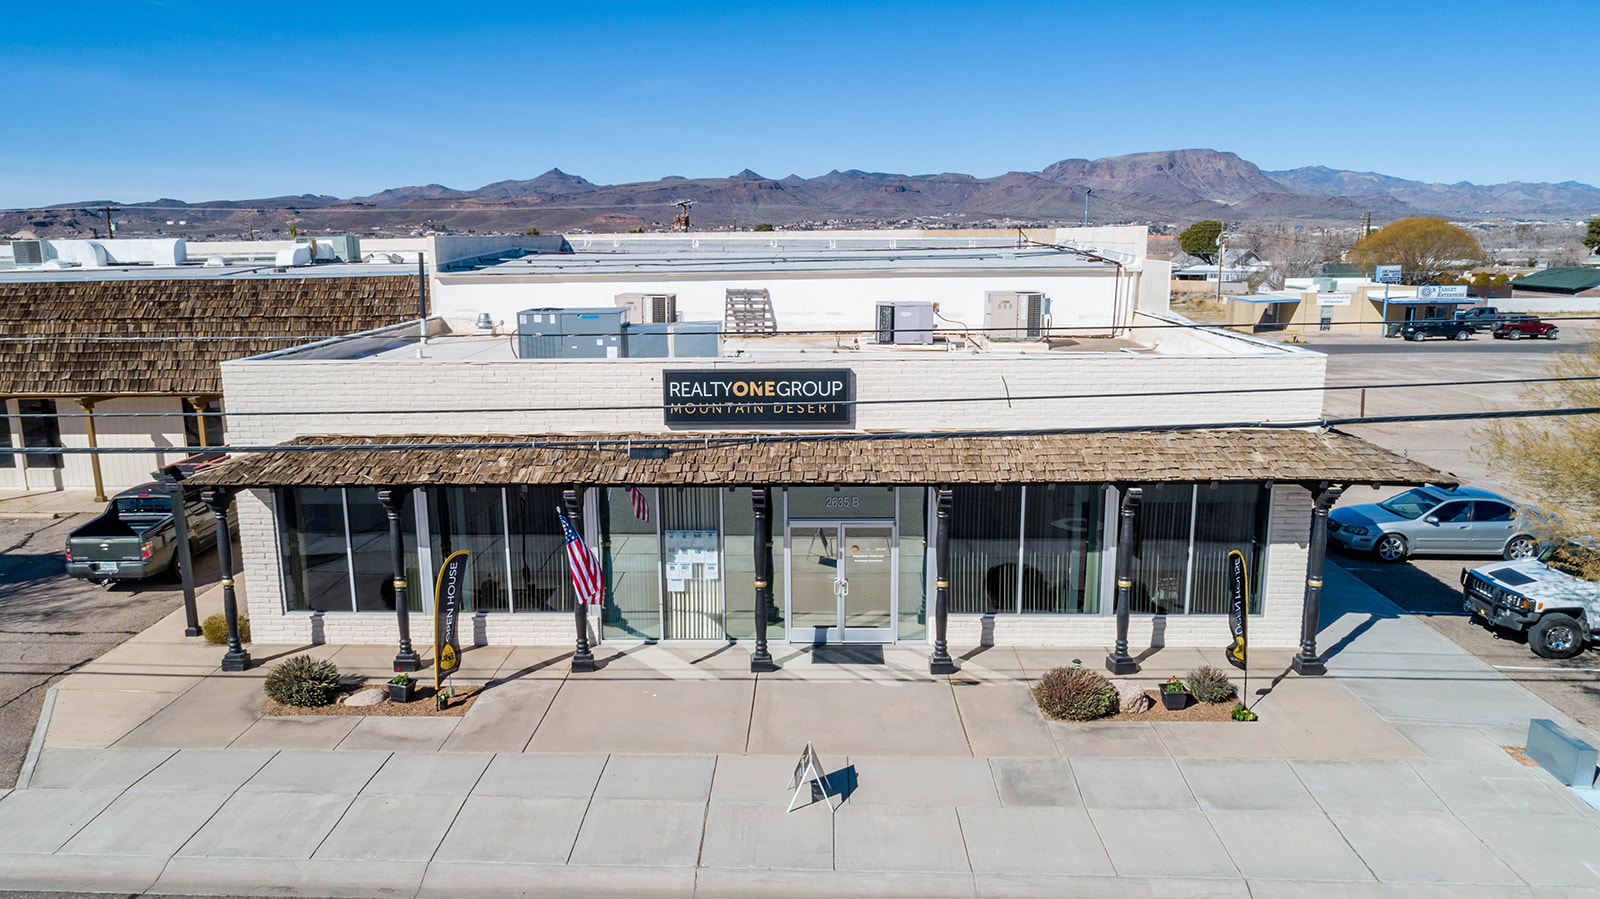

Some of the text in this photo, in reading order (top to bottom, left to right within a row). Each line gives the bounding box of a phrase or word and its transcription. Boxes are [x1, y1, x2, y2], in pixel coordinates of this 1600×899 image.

[669, 380, 843, 397] REALTYONEGROUP
[670, 402, 764, 414] MOUNTAIN
[825, 496, 860, 508] 2635 B
[445, 561, 459, 643] OPEN HOUSE
